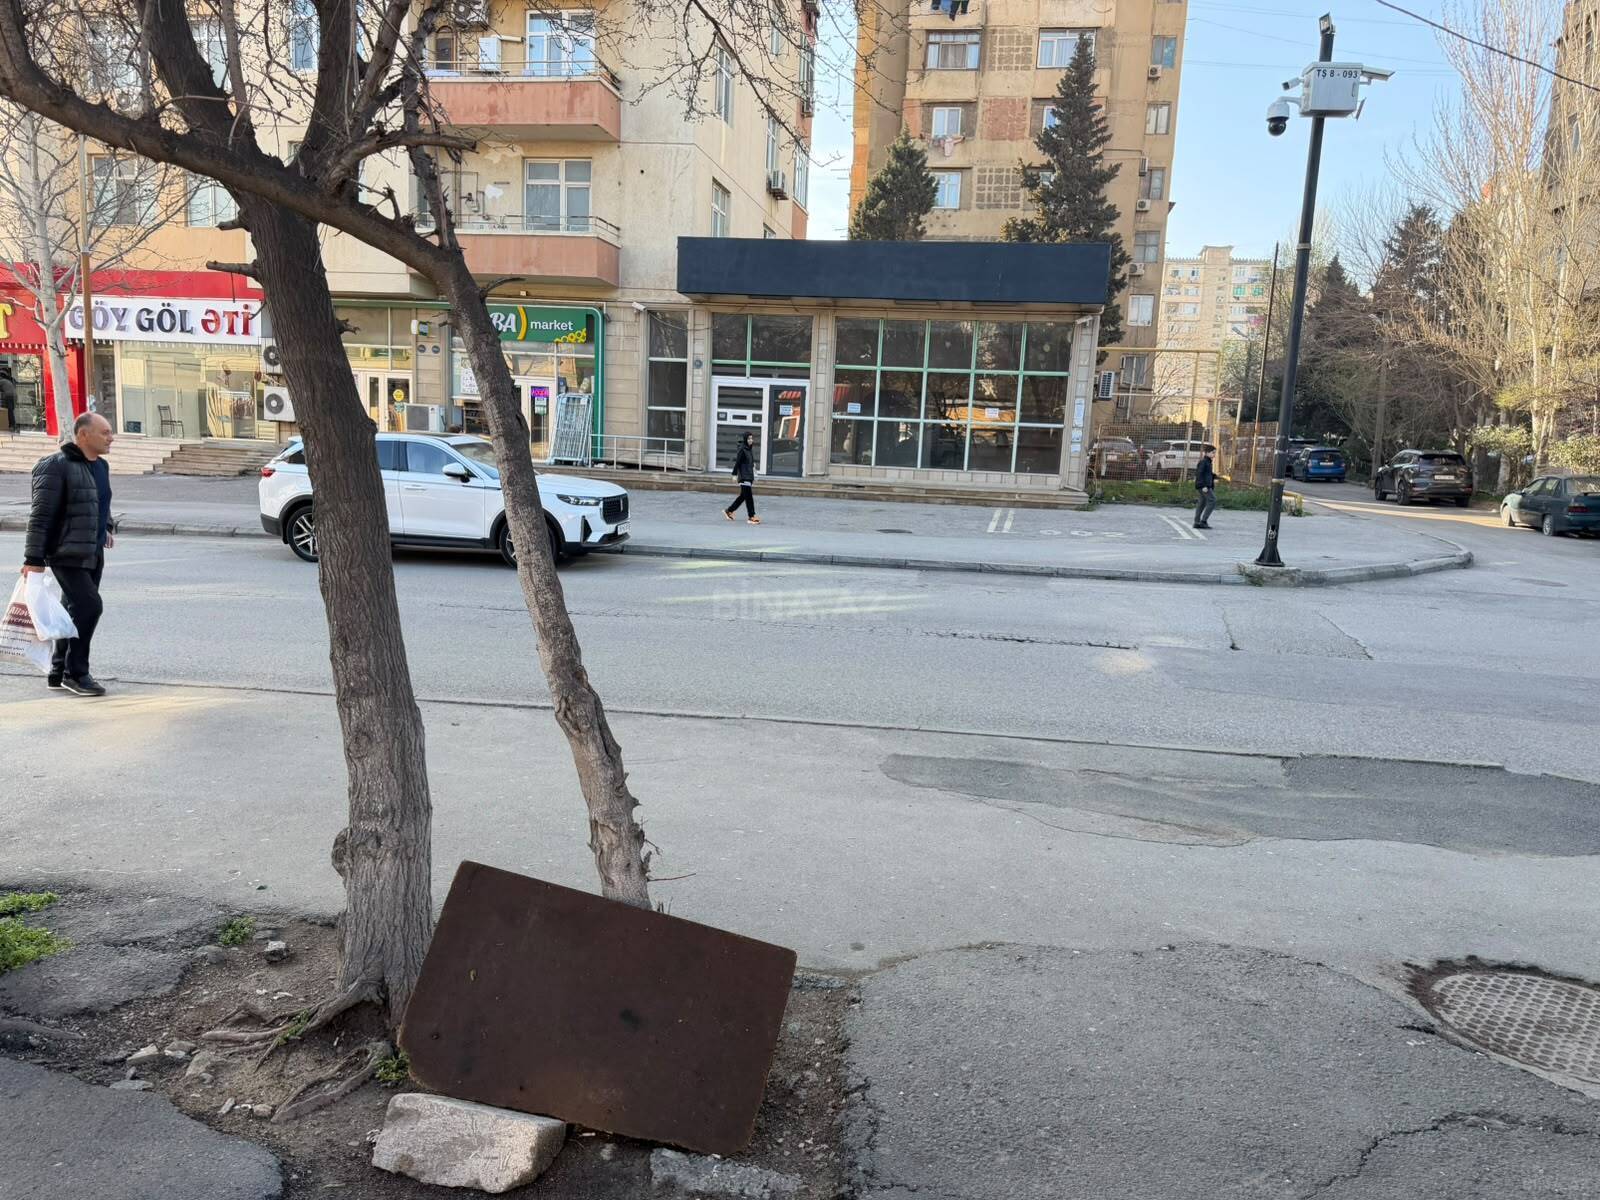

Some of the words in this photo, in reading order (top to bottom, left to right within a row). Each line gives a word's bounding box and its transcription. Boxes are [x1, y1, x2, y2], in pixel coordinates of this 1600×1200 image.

[1329, 69, 1335, 78] 8
[1342, 69, 1358, 79] 093
[68, 300, 129, 332] GÖY
[135, 302, 194, 334] GÖL
[201, 303, 253, 336] ƏTİ
[490, 311, 517, 333] BA
[530, 319, 574, 331] market
